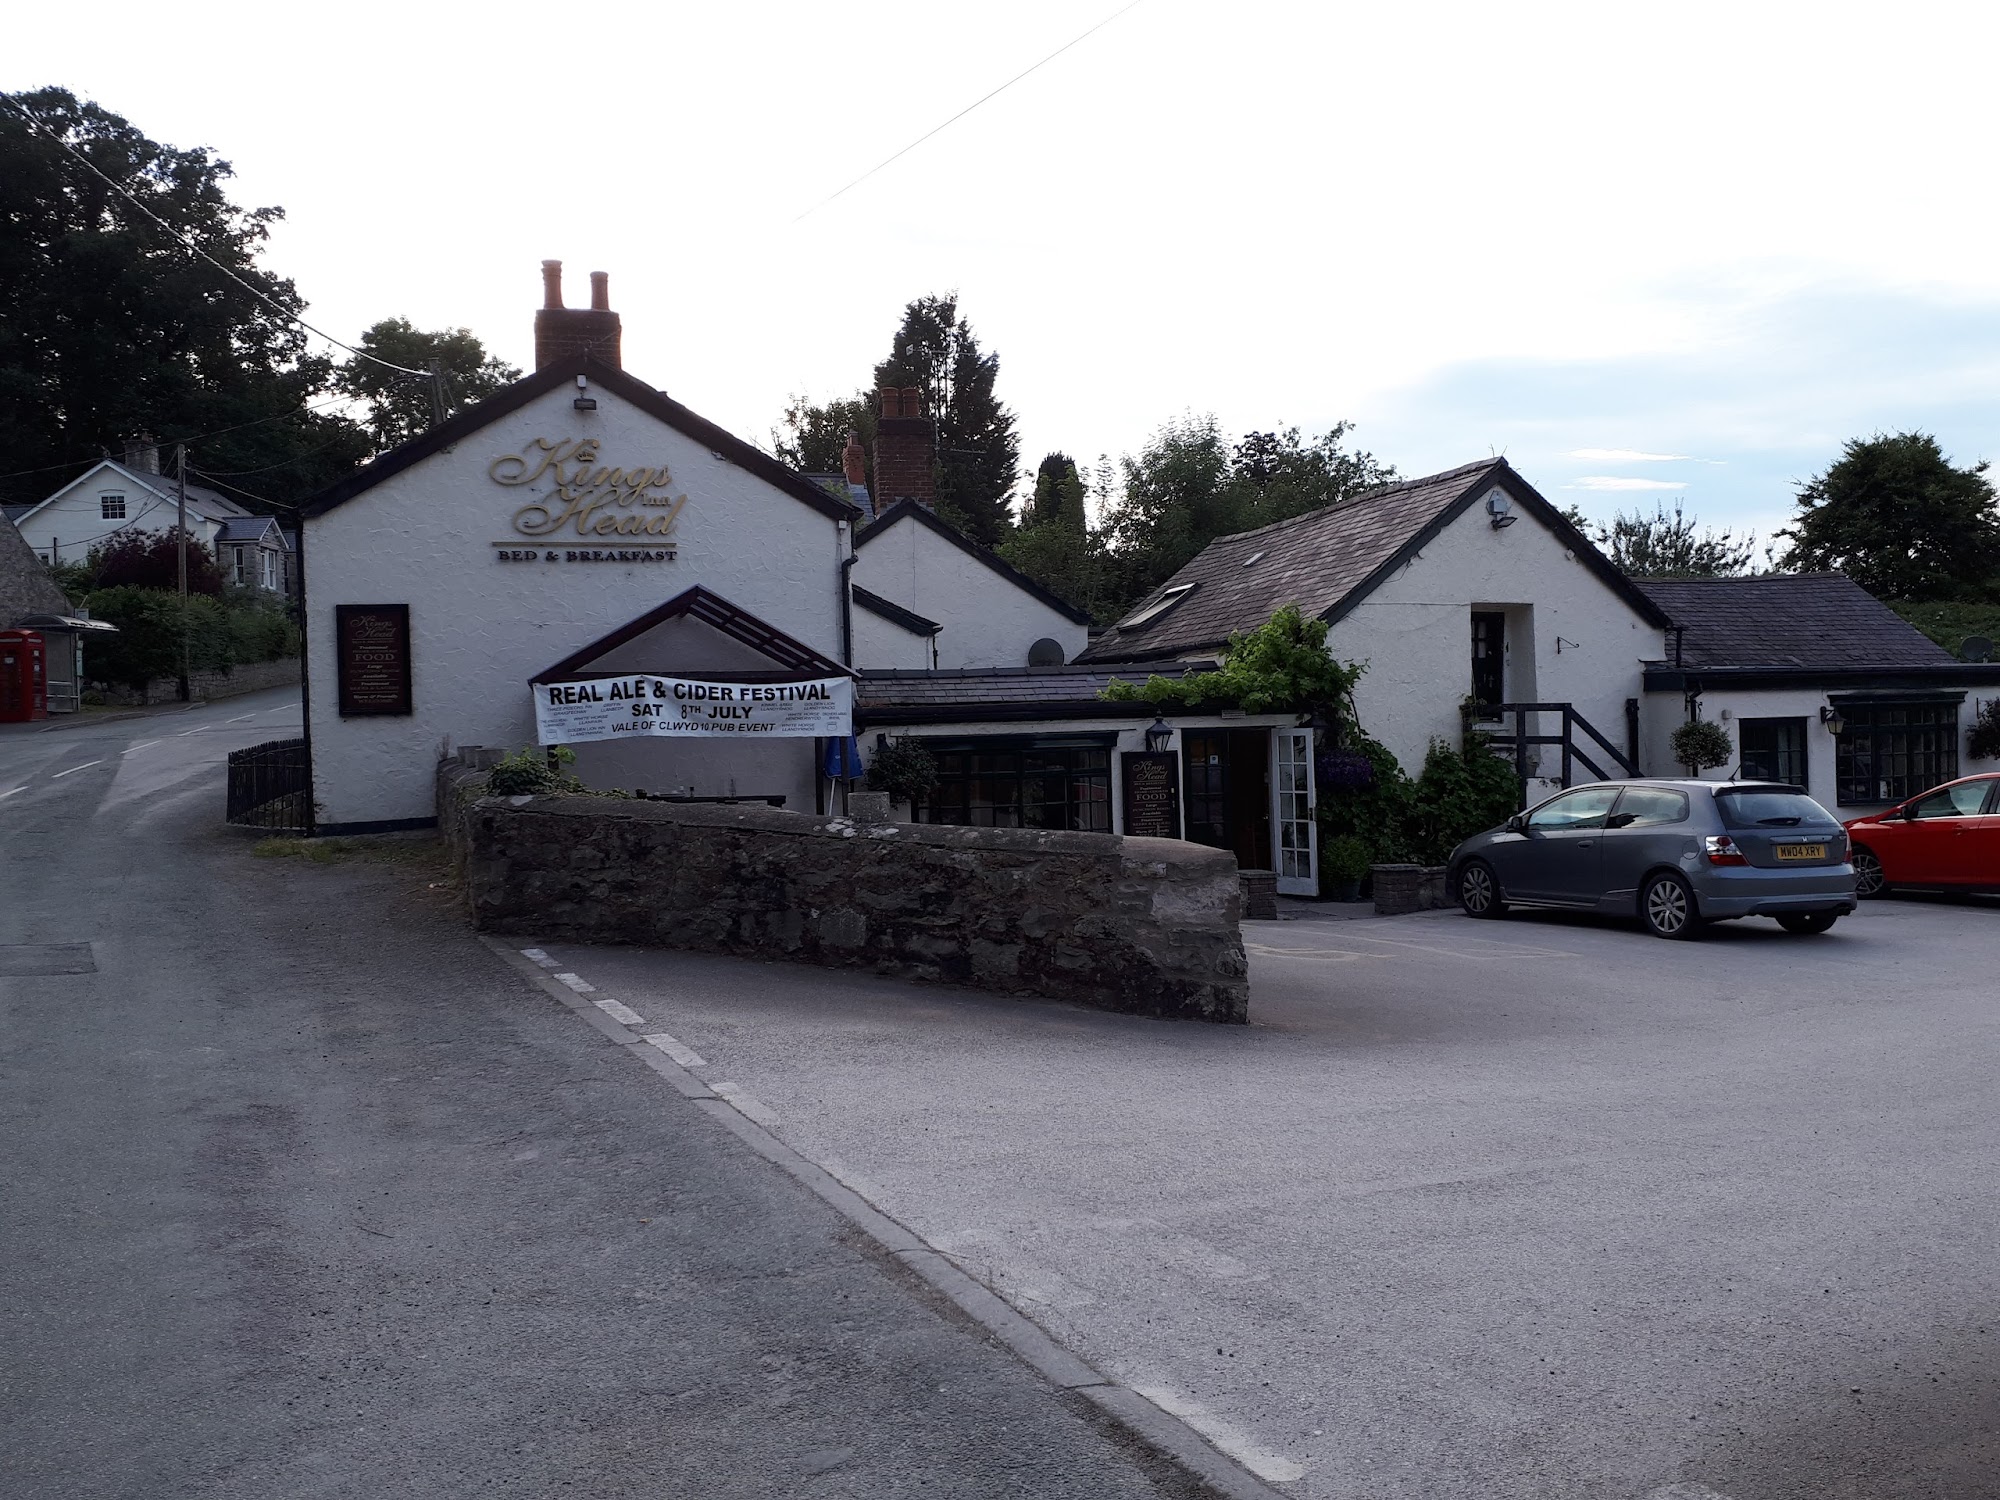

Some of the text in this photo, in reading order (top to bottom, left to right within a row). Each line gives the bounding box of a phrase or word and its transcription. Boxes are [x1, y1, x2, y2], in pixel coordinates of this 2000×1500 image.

[488, 437, 673, 507] Kings
[641, 493, 672, 506] Inn
[512, 486, 688, 535] Head
[498, 550, 677, 563] BED & BREAKFAST
[355, 653, 395, 661] FOOD
[549, 680, 830, 705] REAL ALE & CIDER FESTIVAL
[631, 703, 753, 719] SAT 8TH JULY
[611, 720, 776, 733] VALE OF CLWYD 10 PUB EVENT
[1132, 760, 1165, 773] Kings
[1136, 770, 1168, 780] Head
[1136, 793, 1167, 801] FOOD
[1780, 846, 1820, 857] MW04 XRY
